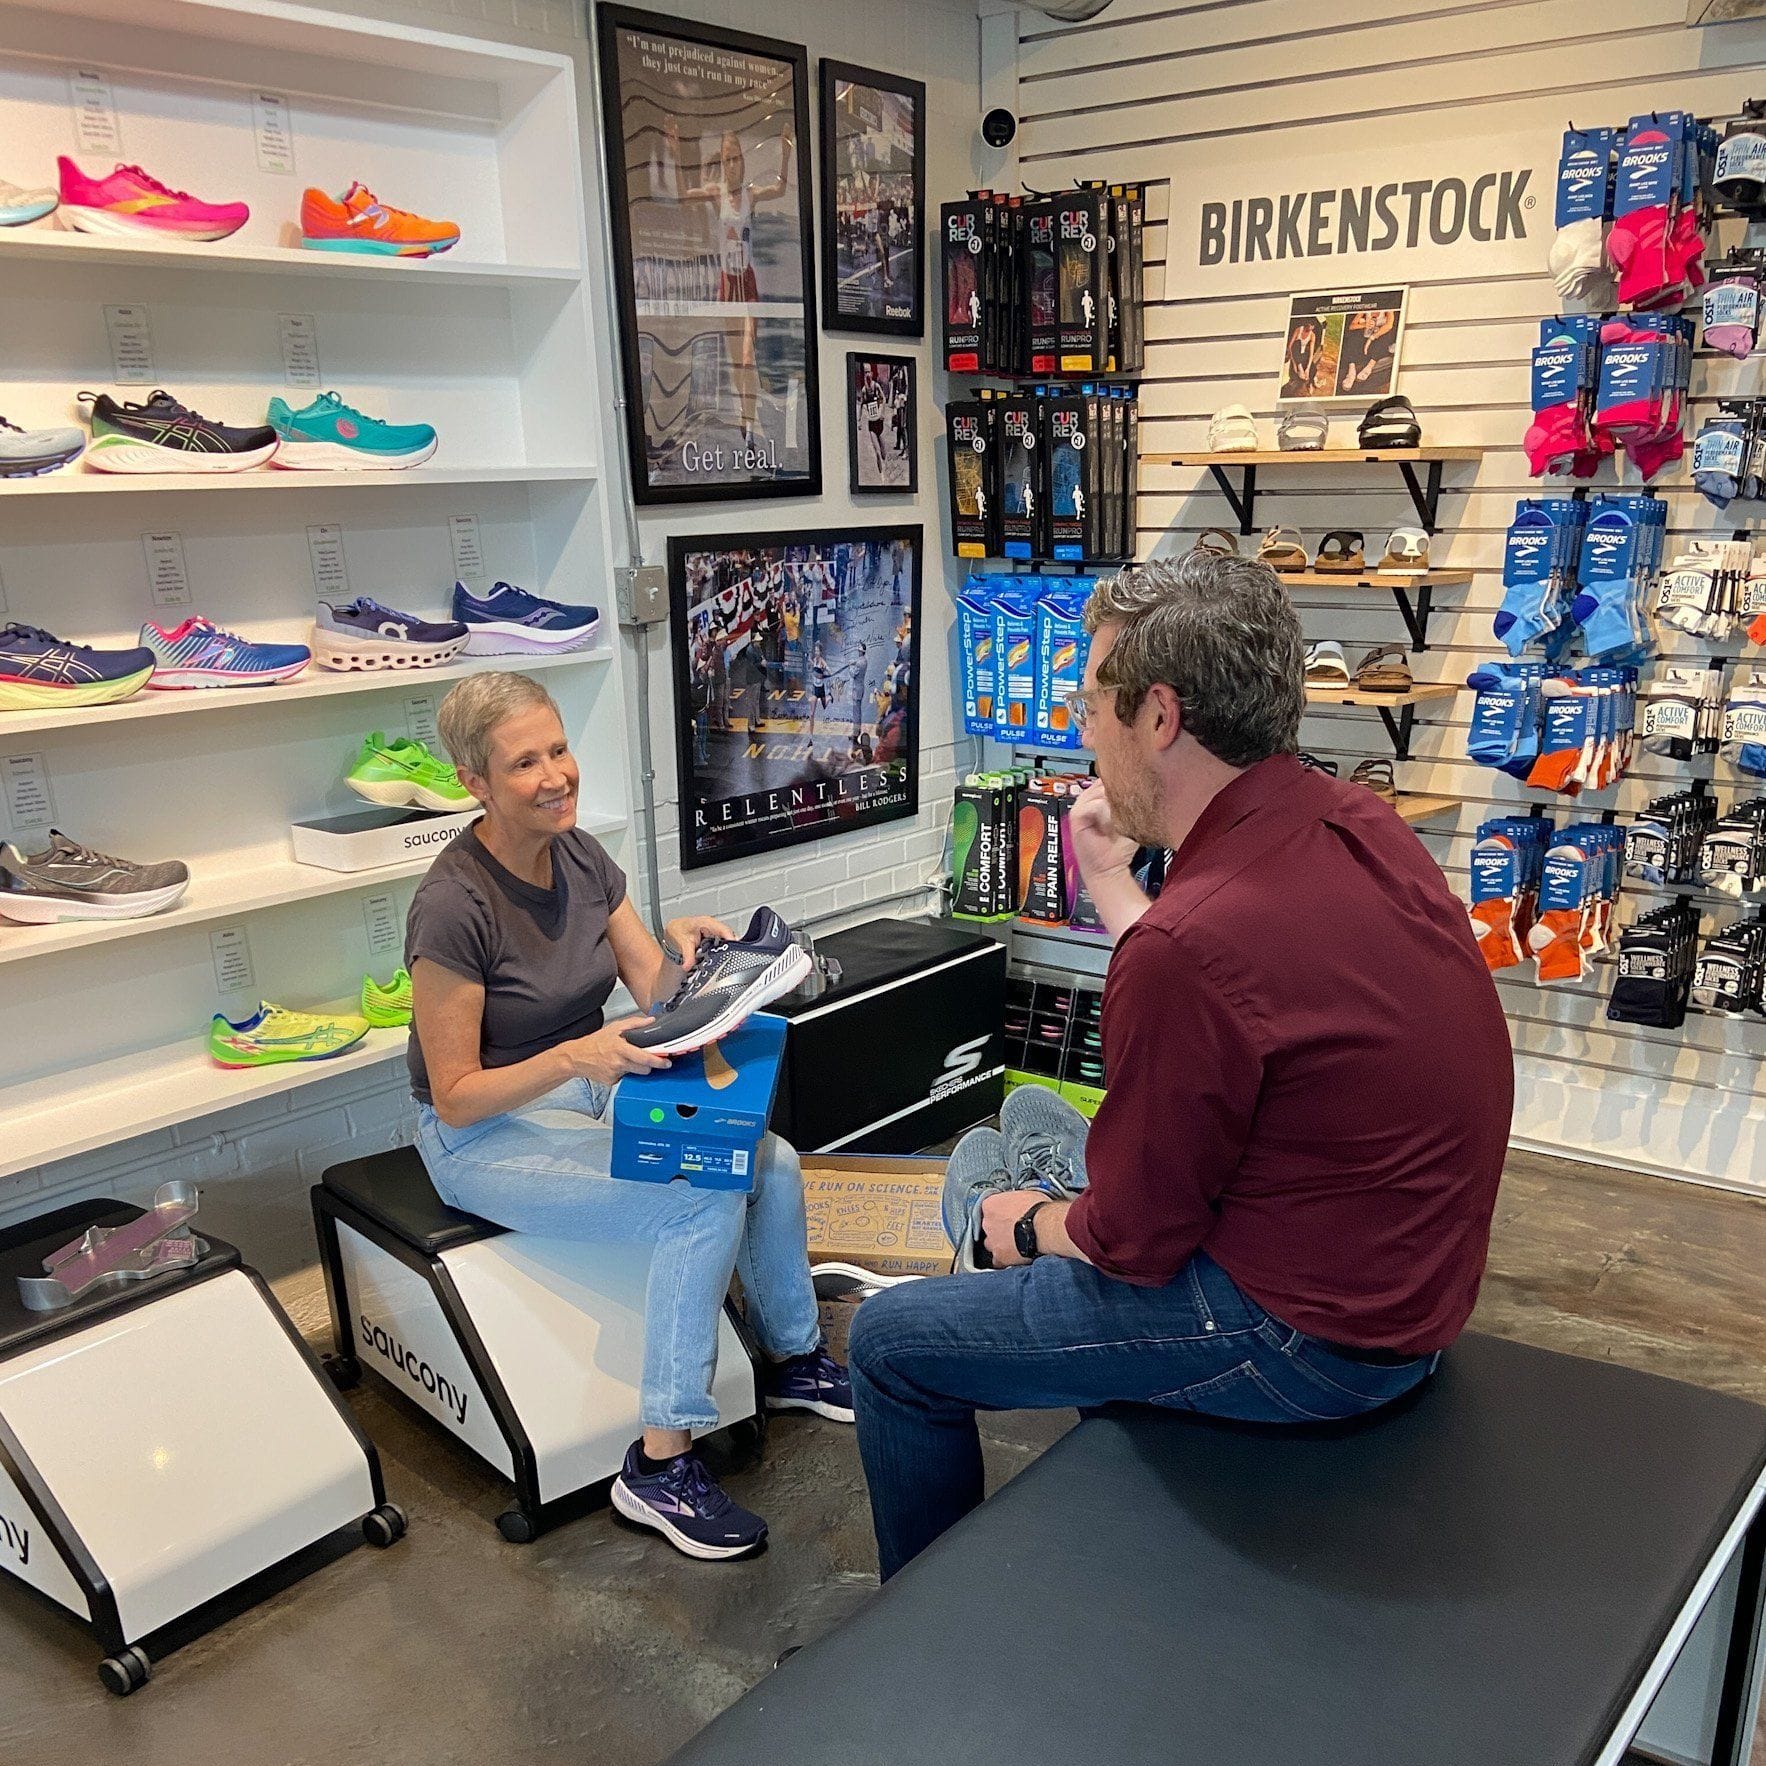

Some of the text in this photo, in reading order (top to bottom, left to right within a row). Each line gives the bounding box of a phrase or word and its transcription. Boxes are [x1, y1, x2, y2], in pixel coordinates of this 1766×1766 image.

[652, 42, 666, 53] not
[668, 45, 714, 64] prejudiced
[716, 56, 746, 70] against
[748, 62, 784, 77] women...
[642, 55, 661, 72] they
[664, 61, 681, 74] just
[683, 65, 704, 78] can't
[707, 71, 722, 82] run
[724, 72, 733, 83] in
[734, 75, 747, 89] my
[1621, 152, 1669, 167] BROOKS
[1561, 166, 1604, 180] BROOKS
[948, 214, 975, 229] CUR
[1059, 210, 1089, 225] CUR
[1199, 169, 1533, 266] BIRKENSTOCK
[949, 228, 975, 242] REX
[1060, 224, 1088, 239] REX
[1737, 292, 1754, 304] AIR
[885, 304, 912, 318] Reebok
[1060, 334, 1093, 343] RUNPRO
[1534, 353, 1574, 367] BROOKS
[1604, 353, 1650, 365] BROOKS
[953, 416, 978, 429] CUR
[1004, 411, 1029, 424] CUR
[1051, 411, 1079, 424] CUR
[954, 429, 978, 441] REX
[1005, 424, 1028, 436] REX
[1052, 424, 1078, 437] REX
[1723, 440, 1740, 451] AIR
[682, 439, 783, 472] Get real.
[957, 525, 985, 533] RUNPRO
[1004, 524, 1031, 533] RUNPRO
[1053, 527, 1083, 535] RUNPRO
[1508, 536, 1549, 546] BROOKS
[1586, 533, 1628, 545] BROOKS
[1675, 575, 1706, 587] ACTIVE
[1672, 585, 1704, 595] COMFORT
[1477, 696, 1515, 708] BROOKS
[1548, 705, 1584, 715] BROOKS
[1658, 706, 1689, 718] ACTIVE
[1656, 716, 1688, 725] COMFORT
[1000, 729, 1026, 738] PULSE
[1041, 733, 1067, 742] PULSE
[695, 766, 907, 827] RELENTLESS
[855, 801, 871, 812] BILL
[872, 793, 907, 807] RODGERS
[1636, 837, 1665, 848] WELLNESS
[1714, 845, 1748, 855] WELLNESS
[979, 822, 992, 893] COMFORT
[1047, 814, 1058, 899] PAIN RELIEF
[1473, 857, 1510, 866] BROOKS
[1544, 865, 1579, 878] BROOKS
[1630, 954, 1664, 962] WELLNESS
[1707, 962, 1740, 974] WELLNESS
[929, 1075, 963, 1096] SKECHERS
[929, 1070, 992, 1104] PERFORMANCE
[683, 1153, 702, 1162] 12.5
[818, 1181, 844, 1192] RUN
[847, 1182, 865, 1192] ON
[868, 1183, 923, 1195] SCIENCE.
[805, 1201, 830, 1213] OOKS
[881, 1260, 902, 1270] RUN
[360, 1315, 469, 1425] saucony
